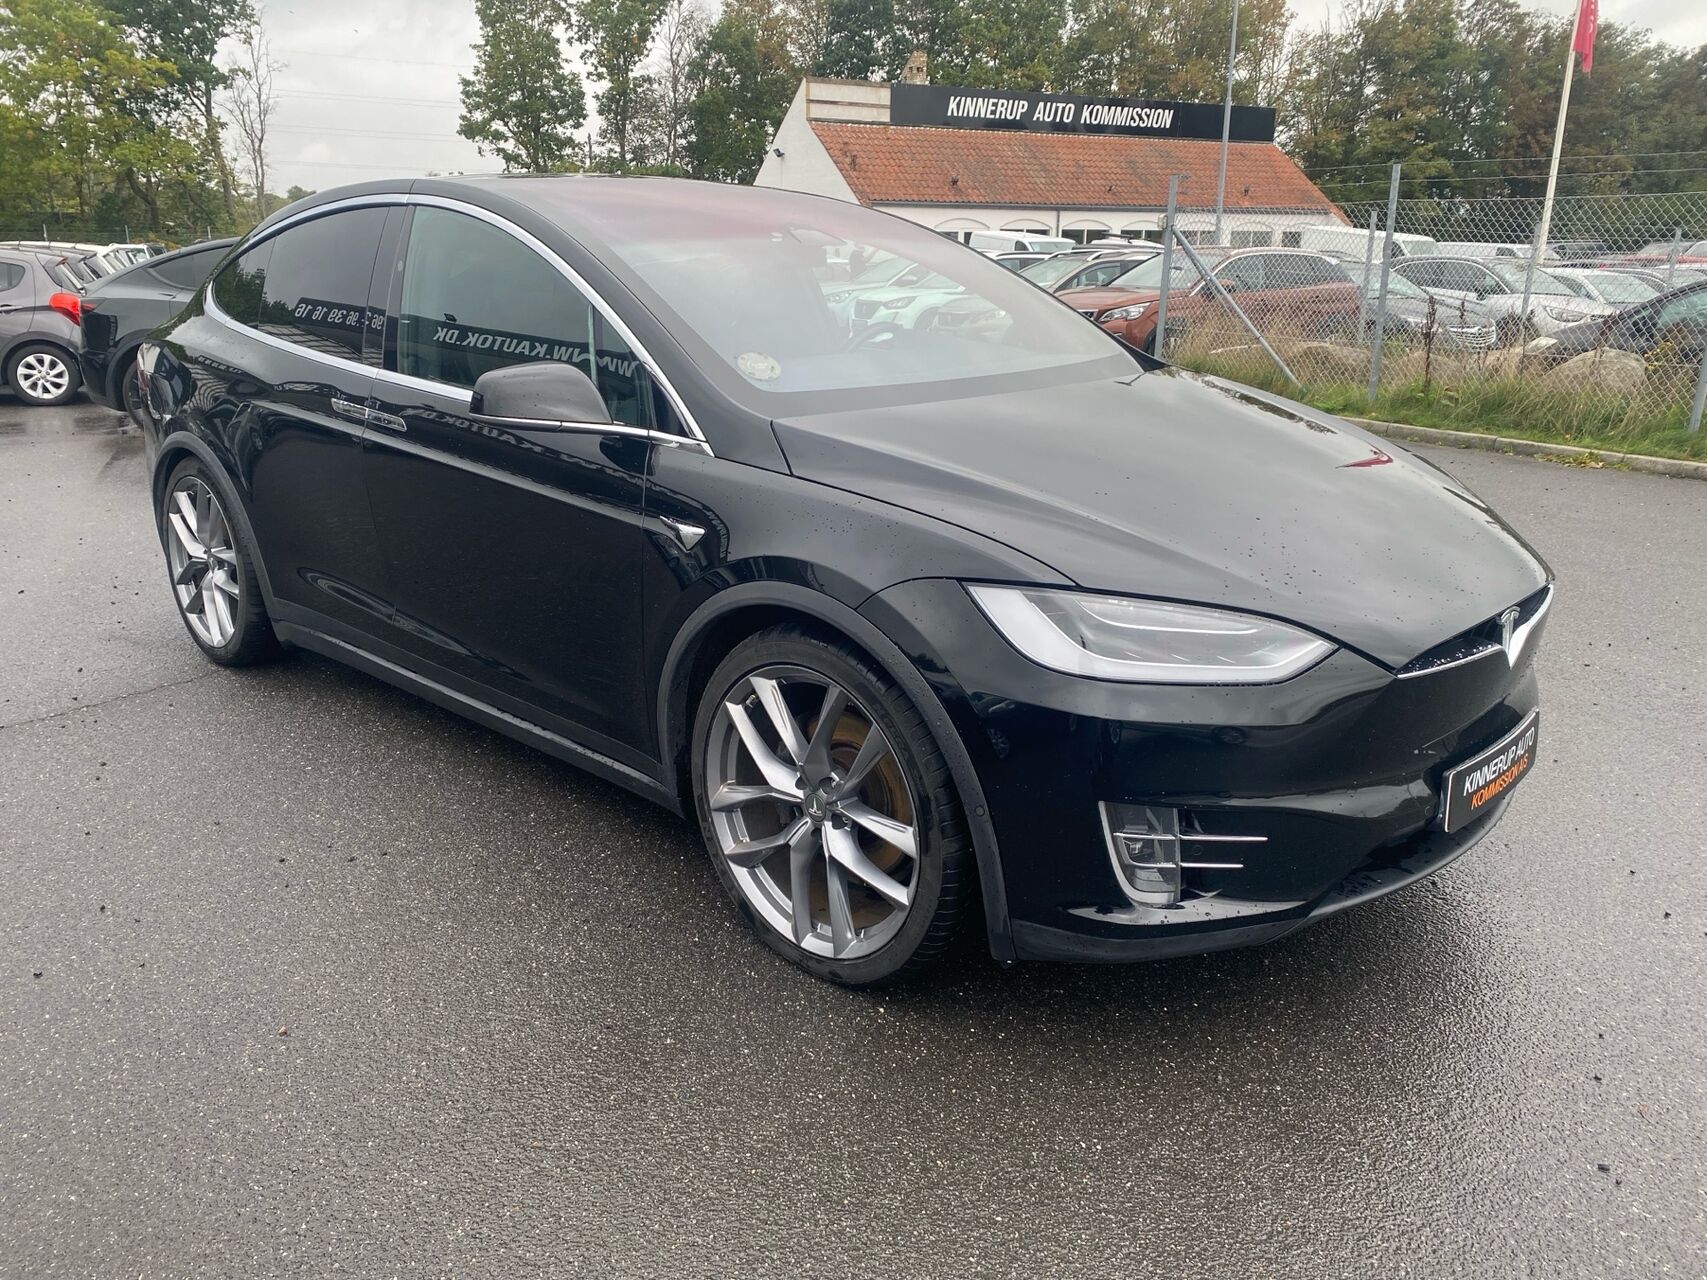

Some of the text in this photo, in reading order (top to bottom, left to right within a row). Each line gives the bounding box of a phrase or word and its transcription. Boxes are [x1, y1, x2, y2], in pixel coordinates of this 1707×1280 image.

[947, 95, 1175, 129] KINNERUP AUTO KOMMISSION
[1463, 726, 1535, 797] KINNERUP AUTO
[1471, 761, 1519, 810] KOMMISSION
